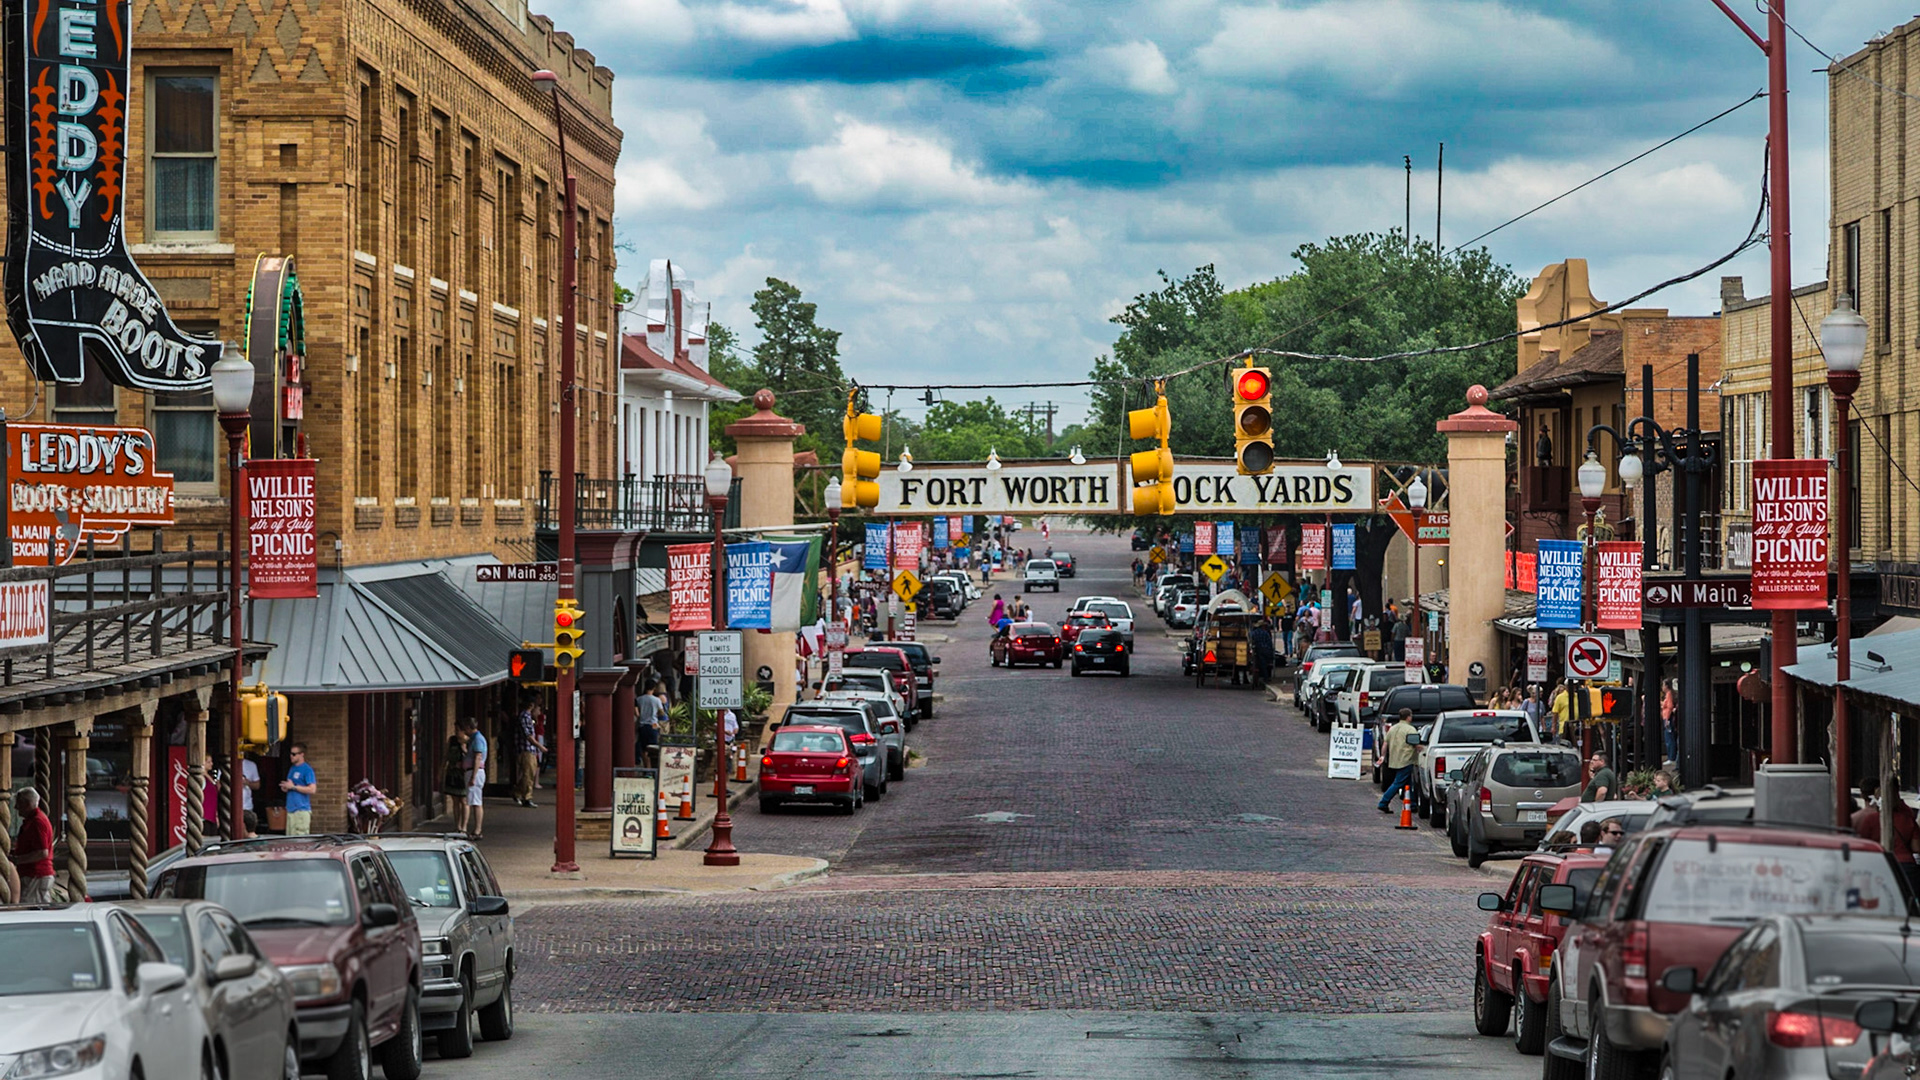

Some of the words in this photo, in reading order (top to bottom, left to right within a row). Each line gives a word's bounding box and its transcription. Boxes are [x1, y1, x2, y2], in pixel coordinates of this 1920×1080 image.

[56, 0, 99, 228] EDDY
[33, 261, 96, 301] HAND
[98, 264, 161, 325] MADE
[101, 297, 206, 380] BOOTS
[21, 432, 146, 475] LEDDY'S
[249, 476, 314, 498] WILLIE
[899, 477, 988, 507] FORT
[1001, 476, 1109, 505] WORTH
[1155, 475, 1237, 505] OCK
[1251, 474, 1353, 505] YARDS
[1754, 477, 1826, 500] WILLIE
[11, 483, 69, 513] BOOTS
[83, 485, 169, 514] SADDLERY
[251, 499, 314, 518] NELSON'S
[1756, 502, 1826, 522] NELSON'S
[250, 519, 268, 531] 4th
[271, 519, 285, 533] of
[287, 518, 314, 533] July
[1428, 515, 1450, 524] RIS
[56, 525, 65, 539] &
[1754, 523, 1775, 536] 4th
[1777, 523, 1793, 538] of
[1795, 522, 1826, 538] July
[251, 533, 314, 555] PICNIC
[1755, 539, 1826, 563] PICNIC
[669, 553, 711, 569] WILLIE
[728, 552, 770, 567] WILLIE
[1539, 550, 1582, 566] WILLIE
[1599, 551, 1642, 566] WILLIE
[255, 575, 310, 583] WILLIESPICNIC.COM
[492, 566, 500, 579] N
[507, 566, 536, 579] Main
[539, 573, 556, 581] 2450
[671, 568, 710, 581] NELSON'S
[729, 566, 770, 579] NELSON'S
[1539, 565, 1581, 578] NELSON'S
[1600, 566, 1641, 579] NELSON'S
[1552, 578, 1561, 587] of
[1612, 579, 1621, 588] of
[1758, 584, 1820, 592] WILLIESPICNIC.COM
[671, 589, 709, 605] PICNIC
[730, 588, 770, 603] PICNIC
[1539, 586, 1580, 601] PICNIC
[1599, 588, 1641, 603] PICNIC
[1671, 584, 1682, 603] N
[1694, 583, 1737, 603] Main
[1880, 573, 1920, 610] MAVE
[0, 584, 45, 639] ADDLES
[701, 666, 728, 674] 54000
[701, 697, 729, 705] 24000
[1333, 736, 1360, 745] VALET
[622, 793, 645, 804] LUNCH
[616, 804, 650, 815] SPECIALS
